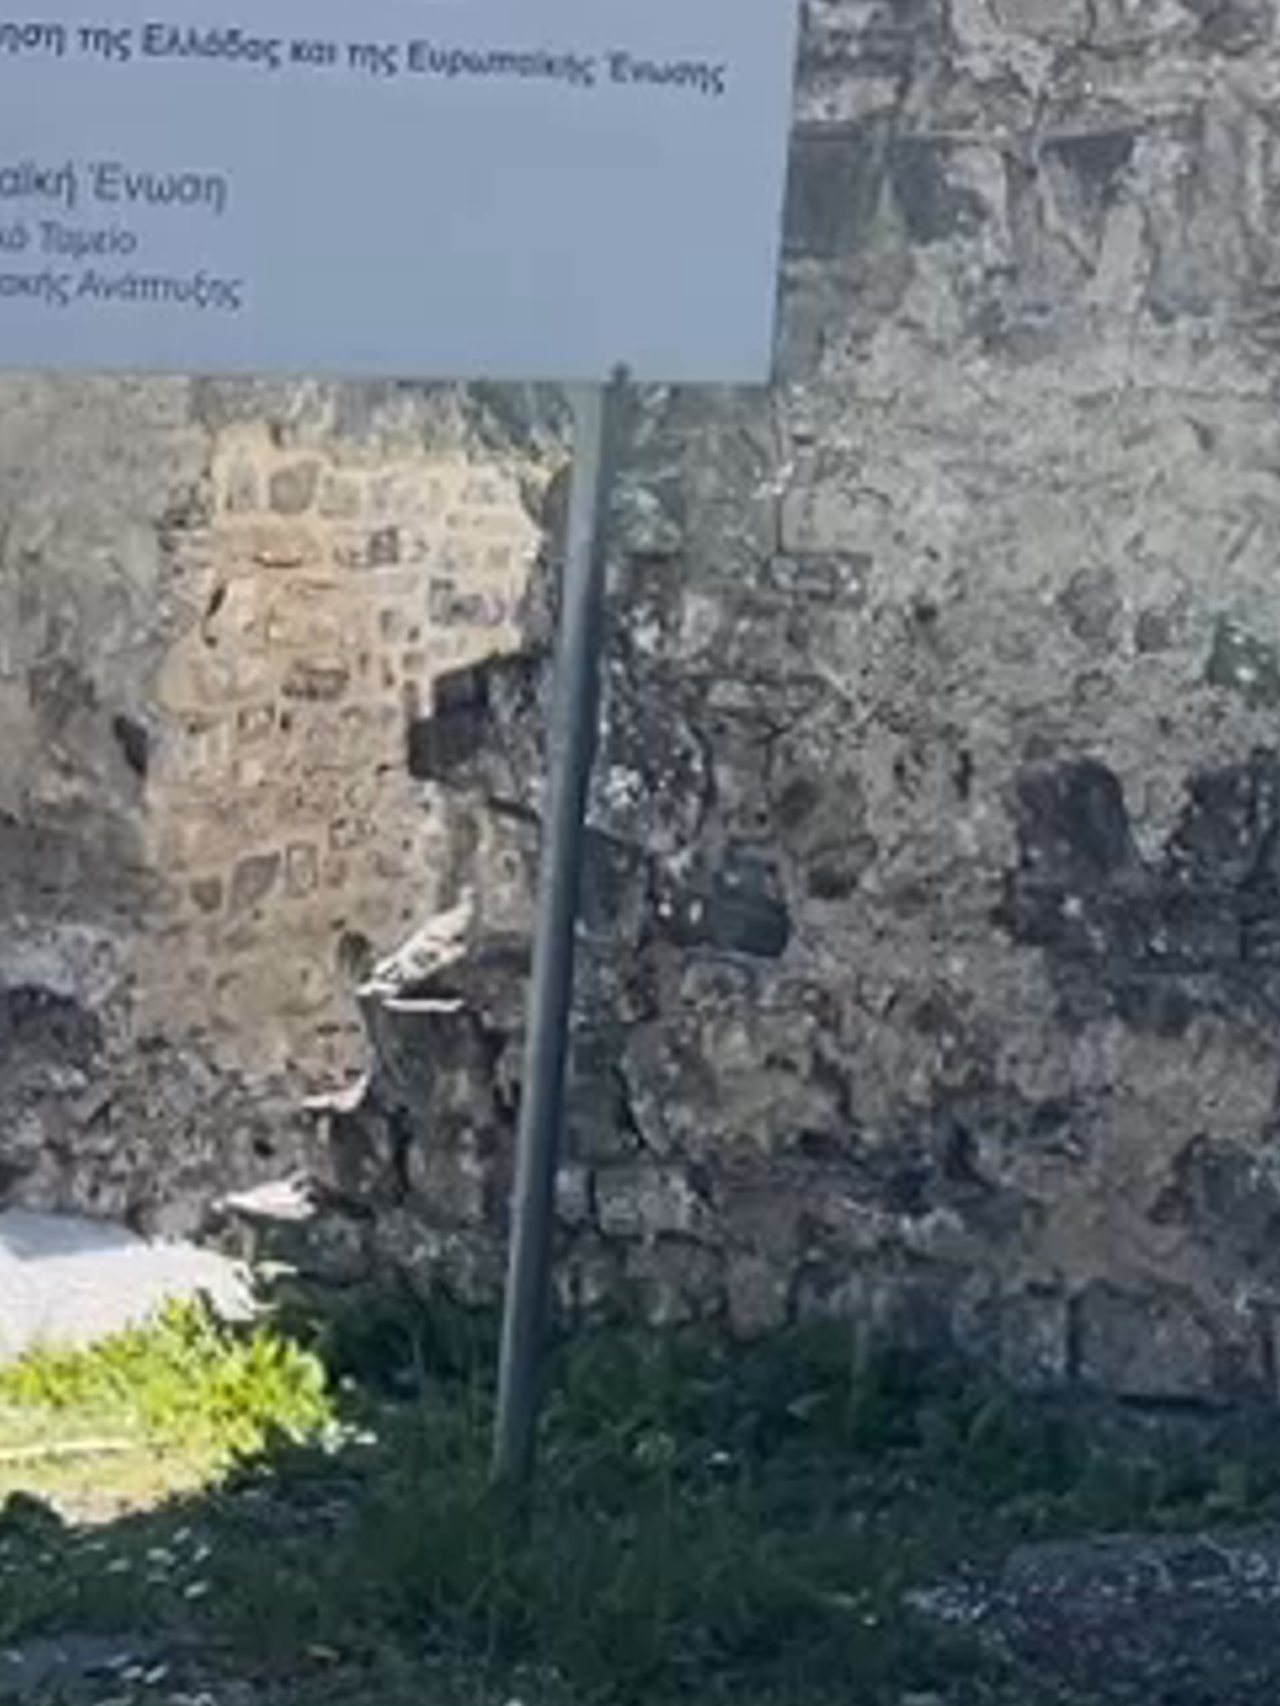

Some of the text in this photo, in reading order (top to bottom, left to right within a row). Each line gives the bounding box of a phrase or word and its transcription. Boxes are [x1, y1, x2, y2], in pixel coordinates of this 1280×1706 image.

[76, 26, 132, 62] της
[140, 23, 282, 67] Ελλάδας
[289, 36, 338, 64] και
[347, 44, 399, 75] της
[607, 51, 725, 92] Ένωσης
[88, 161, 228, 213] Ένωση
[39, 221, 137, 259] Ταμείο
[77, 269, 244, 309] Ανάπτυξης
